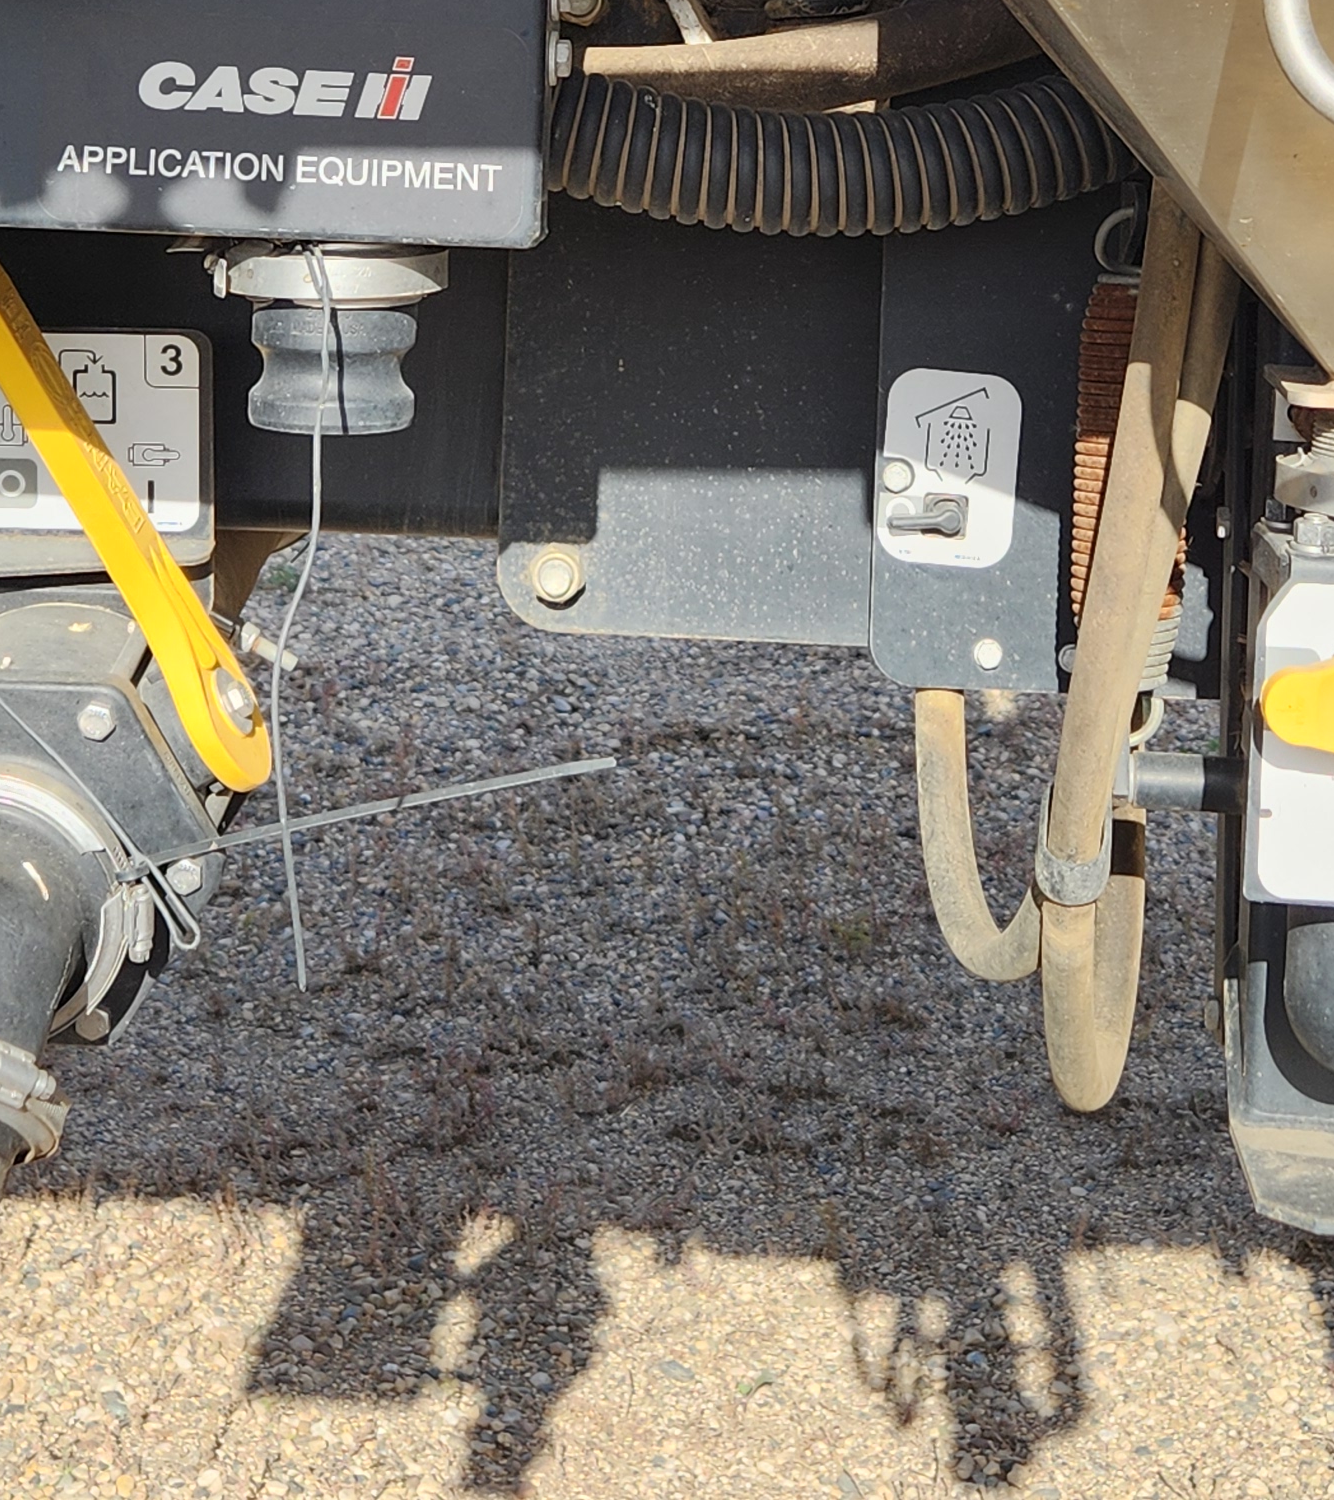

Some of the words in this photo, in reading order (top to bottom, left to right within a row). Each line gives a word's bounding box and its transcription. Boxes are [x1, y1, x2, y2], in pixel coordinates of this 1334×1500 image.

[138, 61, 354, 118] CASE
[57, 145, 284, 183] APPLICATION
[296, 156, 502, 192] EQUIPMENT
[159, 344, 184, 377] 3
